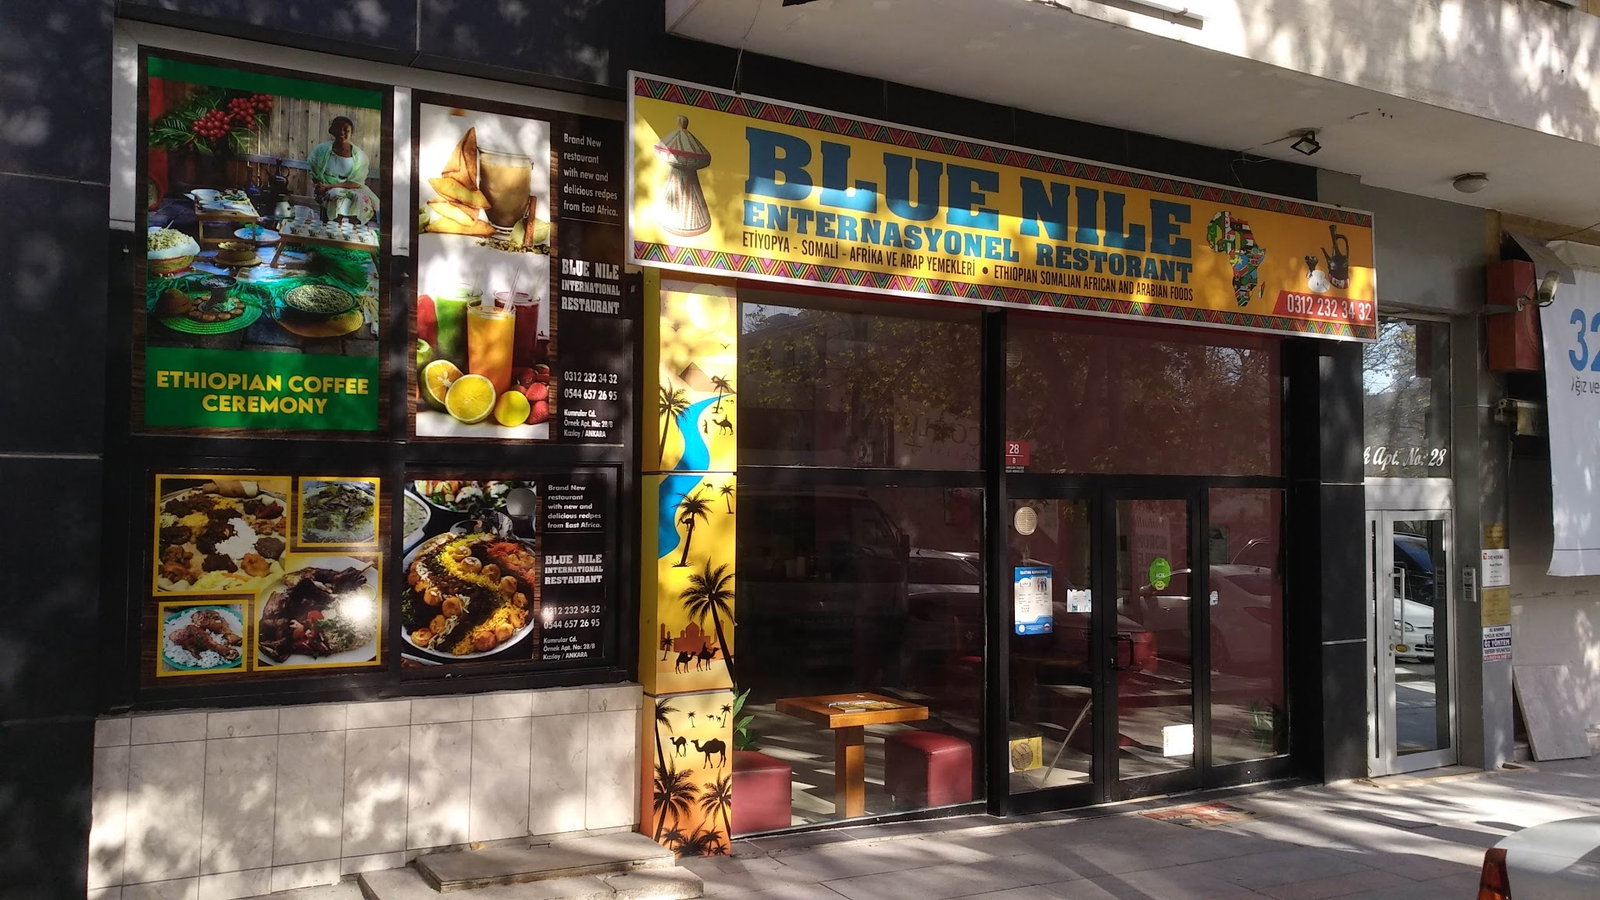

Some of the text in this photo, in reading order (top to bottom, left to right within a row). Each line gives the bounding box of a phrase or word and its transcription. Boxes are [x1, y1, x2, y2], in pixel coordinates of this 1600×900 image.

[564, 133, 602, 148] Brand New
[564, 152, 599, 164] restaurant
[563, 167, 609, 182] with new and
[564, 183, 594, 197] delicious
[745, 127, 1192, 258] BLUE NILE
[563, 200, 618, 216] from East Africa.
[743, 199, 1193, 284] ENTERNASYONEL RESTORANT
[562, 258, 620, 280] BLUE NILE
[742, 230, 790, 253] ETİYOPYA
[801, 240, 839, 259] SOMALİ
[850, 245, 883, 266] AFRİKA
[886, 251, 898, 267] VE
[900, 253, 923, 270] ARAP
[927, 256, 976, 276] YEMEKLERİ
[994, 265, 1038, 284] ETHIOPIAN
[1040, 271, 1081, 289] SOMALIAN
[1083, 276, 1116, 293] AFRICAN
[1118, 280, 1135, 295] AND
[1136, 282, 1168, 298] ARABIAN
[1170, 286, 1193, 301] FOODS
[561, 279, 621, 296] INTERNATIONAL
[561, 296, 620, 315] RESTAURANT
[1287, 293, 1372, 321] 0312 232 34 32
[156, 370, 369, 395] ETHIOPIAN COFFEE
[564, 371, 618, 384] 0312 232 34 32
[564, 388, 617, 400] 0544 657 26 95
[202, 394, 328, 414] CEREMONY
[564, 417, 580, 427] Örnek
[580, 419, 590, 428] Apt.
[585, 430, 606, 438] ANKARA
[1009, 443, 1020, 454] 28
[1372, 446, 1400, 471] Apt.
[1428, 448, 1447, 467] 28
[545, 554, 602, 564] BLUE NILE
[544, 565, 603, 574] INTERNATIONAL
[544, 575, 602, 585] RESTAURANT
[544, 605, 600, 615] 0312 232 34 32
[543, 618, 600, 629] 0544 657 26 95
[543, 644, 560, 652] Örnek
[565, 651, 588, 659] ANKARA
